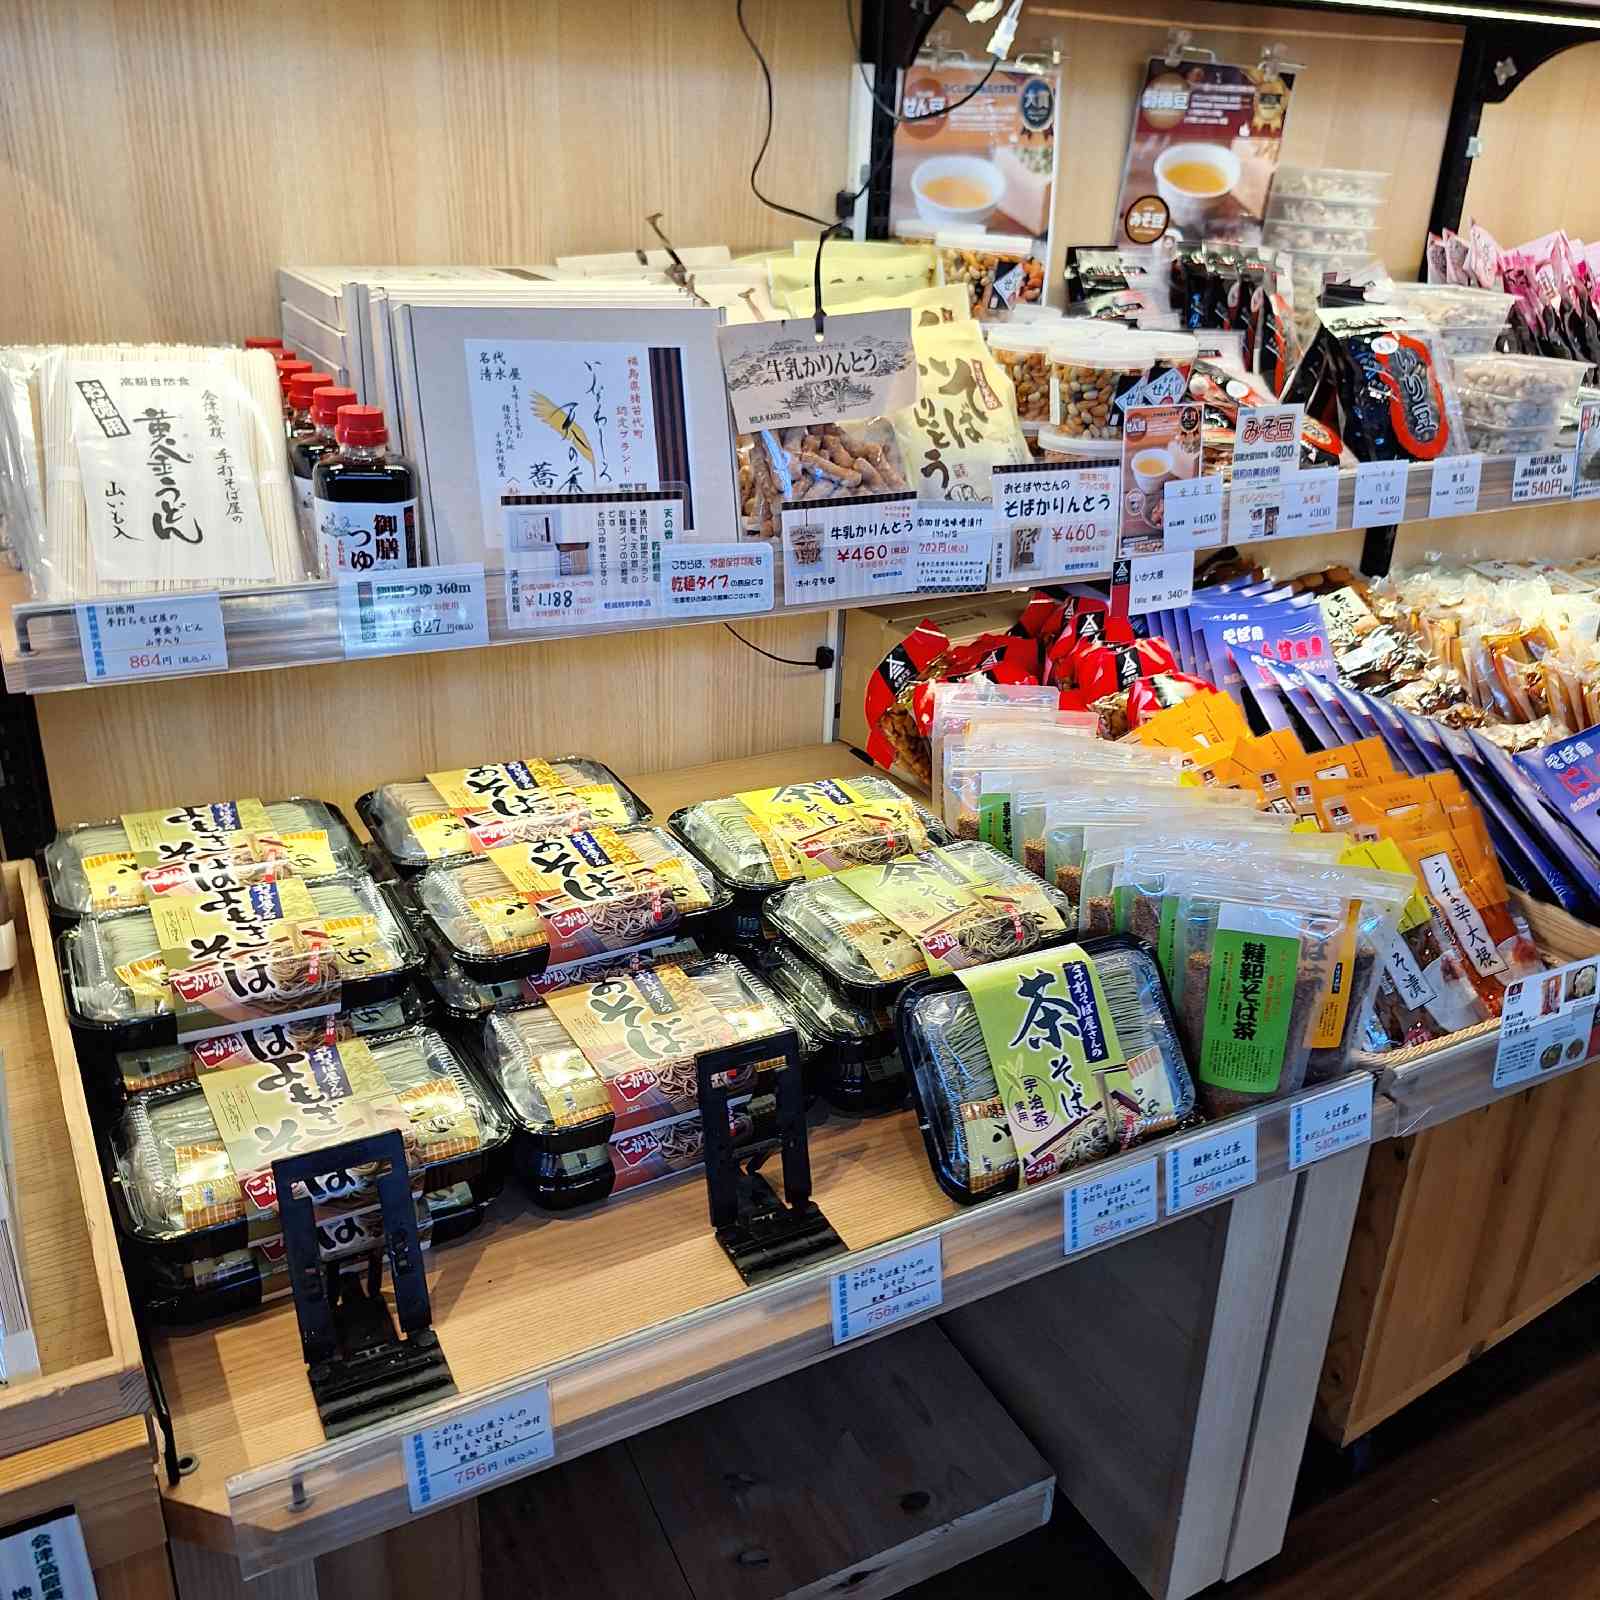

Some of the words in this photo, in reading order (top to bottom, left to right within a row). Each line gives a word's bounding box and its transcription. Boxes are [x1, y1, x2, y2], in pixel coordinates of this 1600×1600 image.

[480, 350, 507, 365] 名代
[766, 348, 879, 383] 牛乳かりんとう
[479, 367, 523, 382] 清水屋
[1242, 414, 1297, 444] みそ豆
[132, 407, 204, 544] 黄金うどん
[1003, 479, 1071, 495] おそばやさんの
[1531, 478, 1562, 496] 540円
[1003, 496, 1112, 519] そばかりんとう
[373, 514, 400, 561] 御膳
[830, 519, 914, 540] 牛乳かりんとう
[1051, 523, 1097, 542] ¥460
[350, 529, 375, 572] つゆ
[836, 544, 889, 563] ¥460
[412, 618, 443, 635] 627
[128, 654, 173, 670] 864円
[190, 934, 276, 998] そば
[1008, 967, 1090, 1119] 茶そば
[615, 1071, 656, 1092] こがね
[1023, 1078, 1049, 1128] 宇治茶
[1323, 1103, 1351, 1121] そば茶
[453, 1461, 499, 1485] 756円
